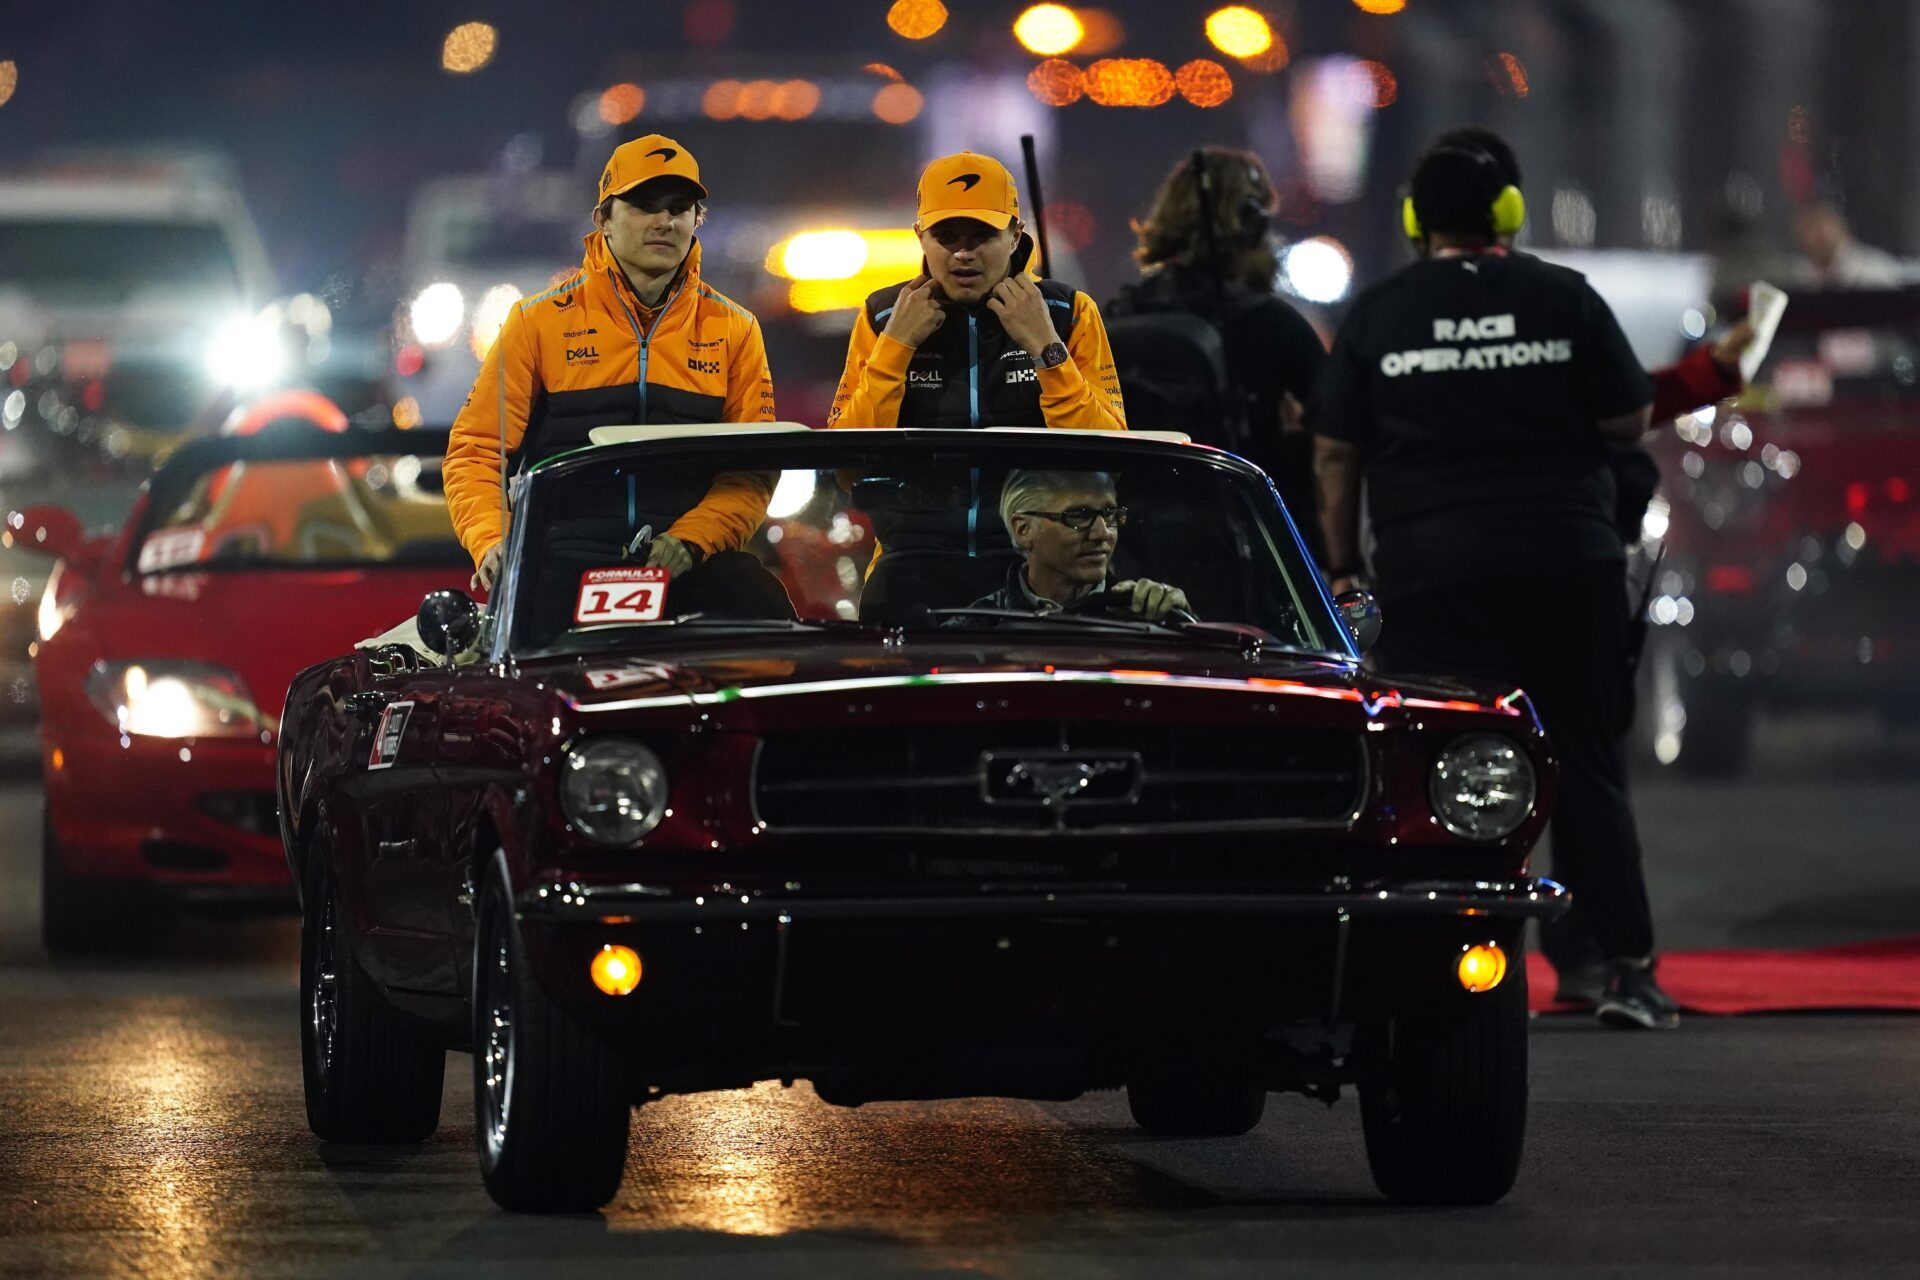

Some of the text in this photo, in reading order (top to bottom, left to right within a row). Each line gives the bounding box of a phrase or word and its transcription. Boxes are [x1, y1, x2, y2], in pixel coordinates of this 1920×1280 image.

[563, 329, 587, 338] android
[1432, 313, 1516, 342] RACE
[566, 346, 599, 361] DELL
[1379, 339, 1572, 377] OPERATIONS
[909, 369, 943, 382] DELL
[588, 569, 655, 580] FORMULA
[656, 569, 664, 578] 1
[583, 589, 653, 615] 14
